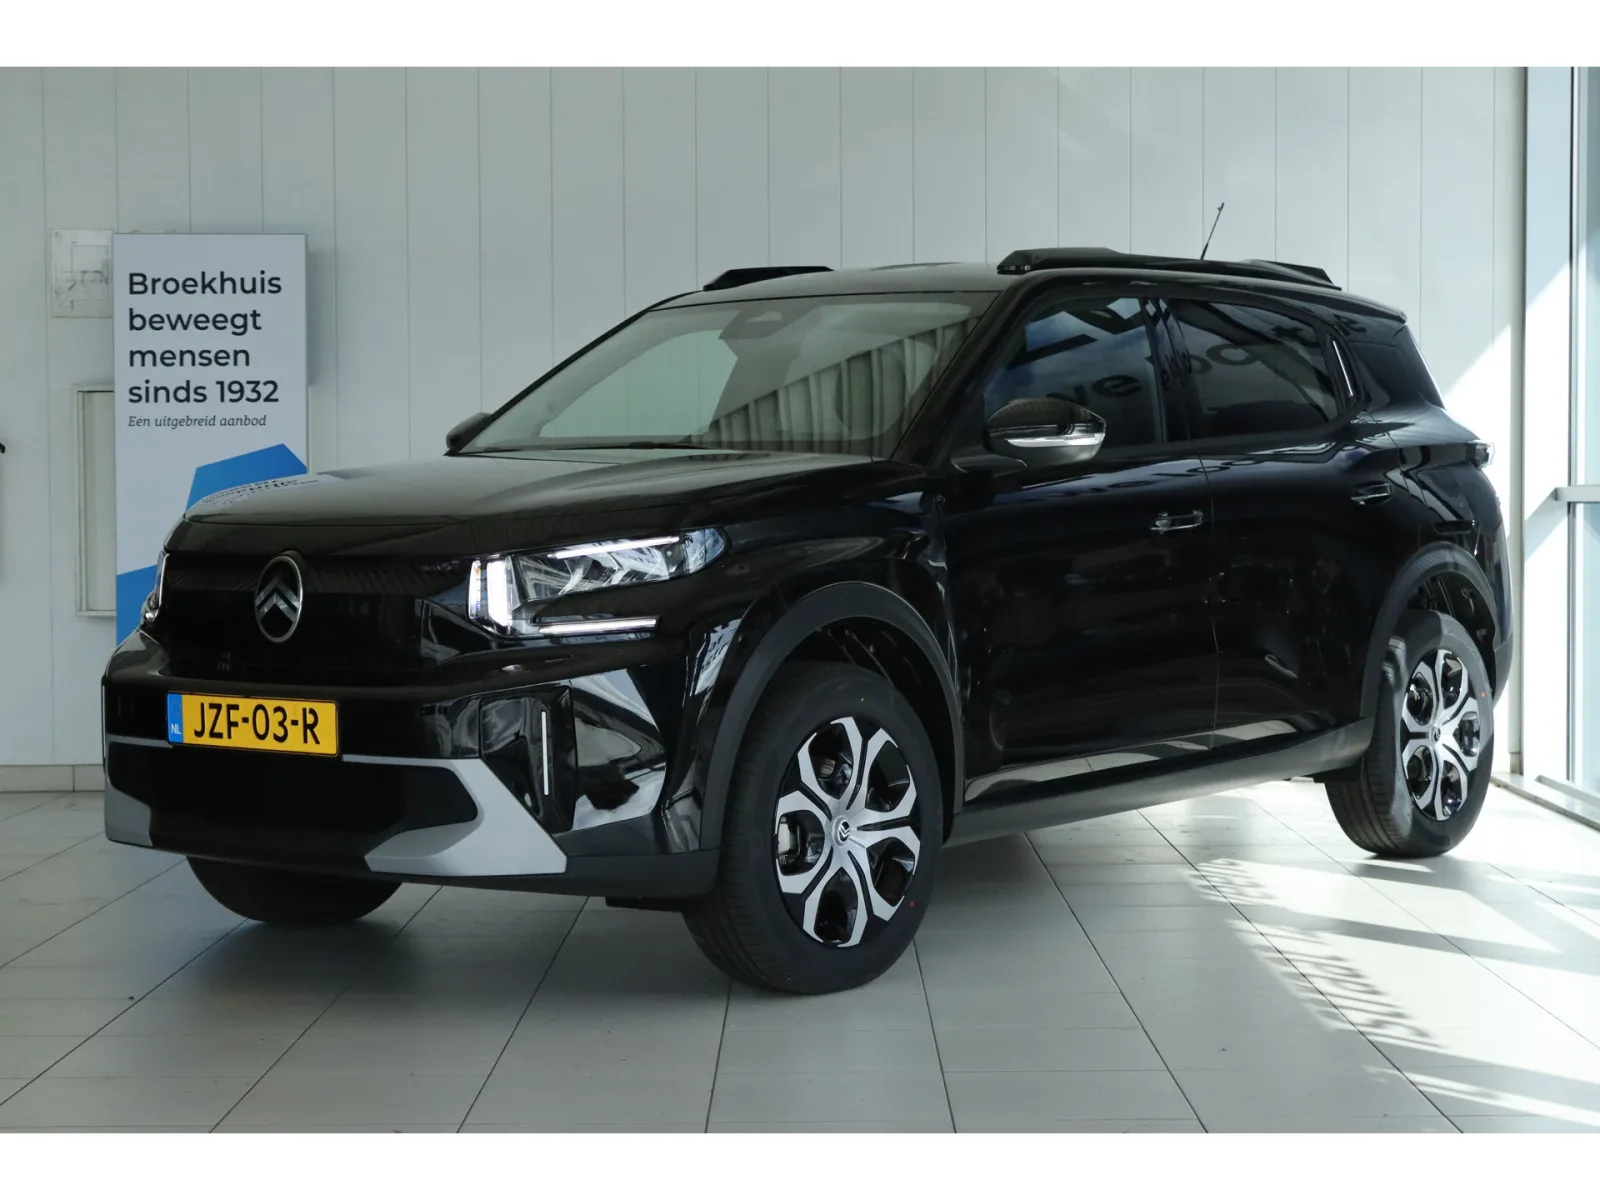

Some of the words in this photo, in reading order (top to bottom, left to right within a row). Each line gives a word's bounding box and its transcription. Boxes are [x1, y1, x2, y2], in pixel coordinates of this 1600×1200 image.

[128, 269, 282, 295] Broekhuis
[128, 307, 262, 336] beweegt
[129, 349, 250, 367] mensen
[128, 379, 208, 403] sinds
[215, 380, 279, 403] 1932
[127, 415, 151, 427] Een
[154, 415, 217, 430] uitgebreid
[219, 414, 267, 427] aanbod
[170, 724, 182, 735] NL
[194, 702, 321, 745] JZF-03-R
